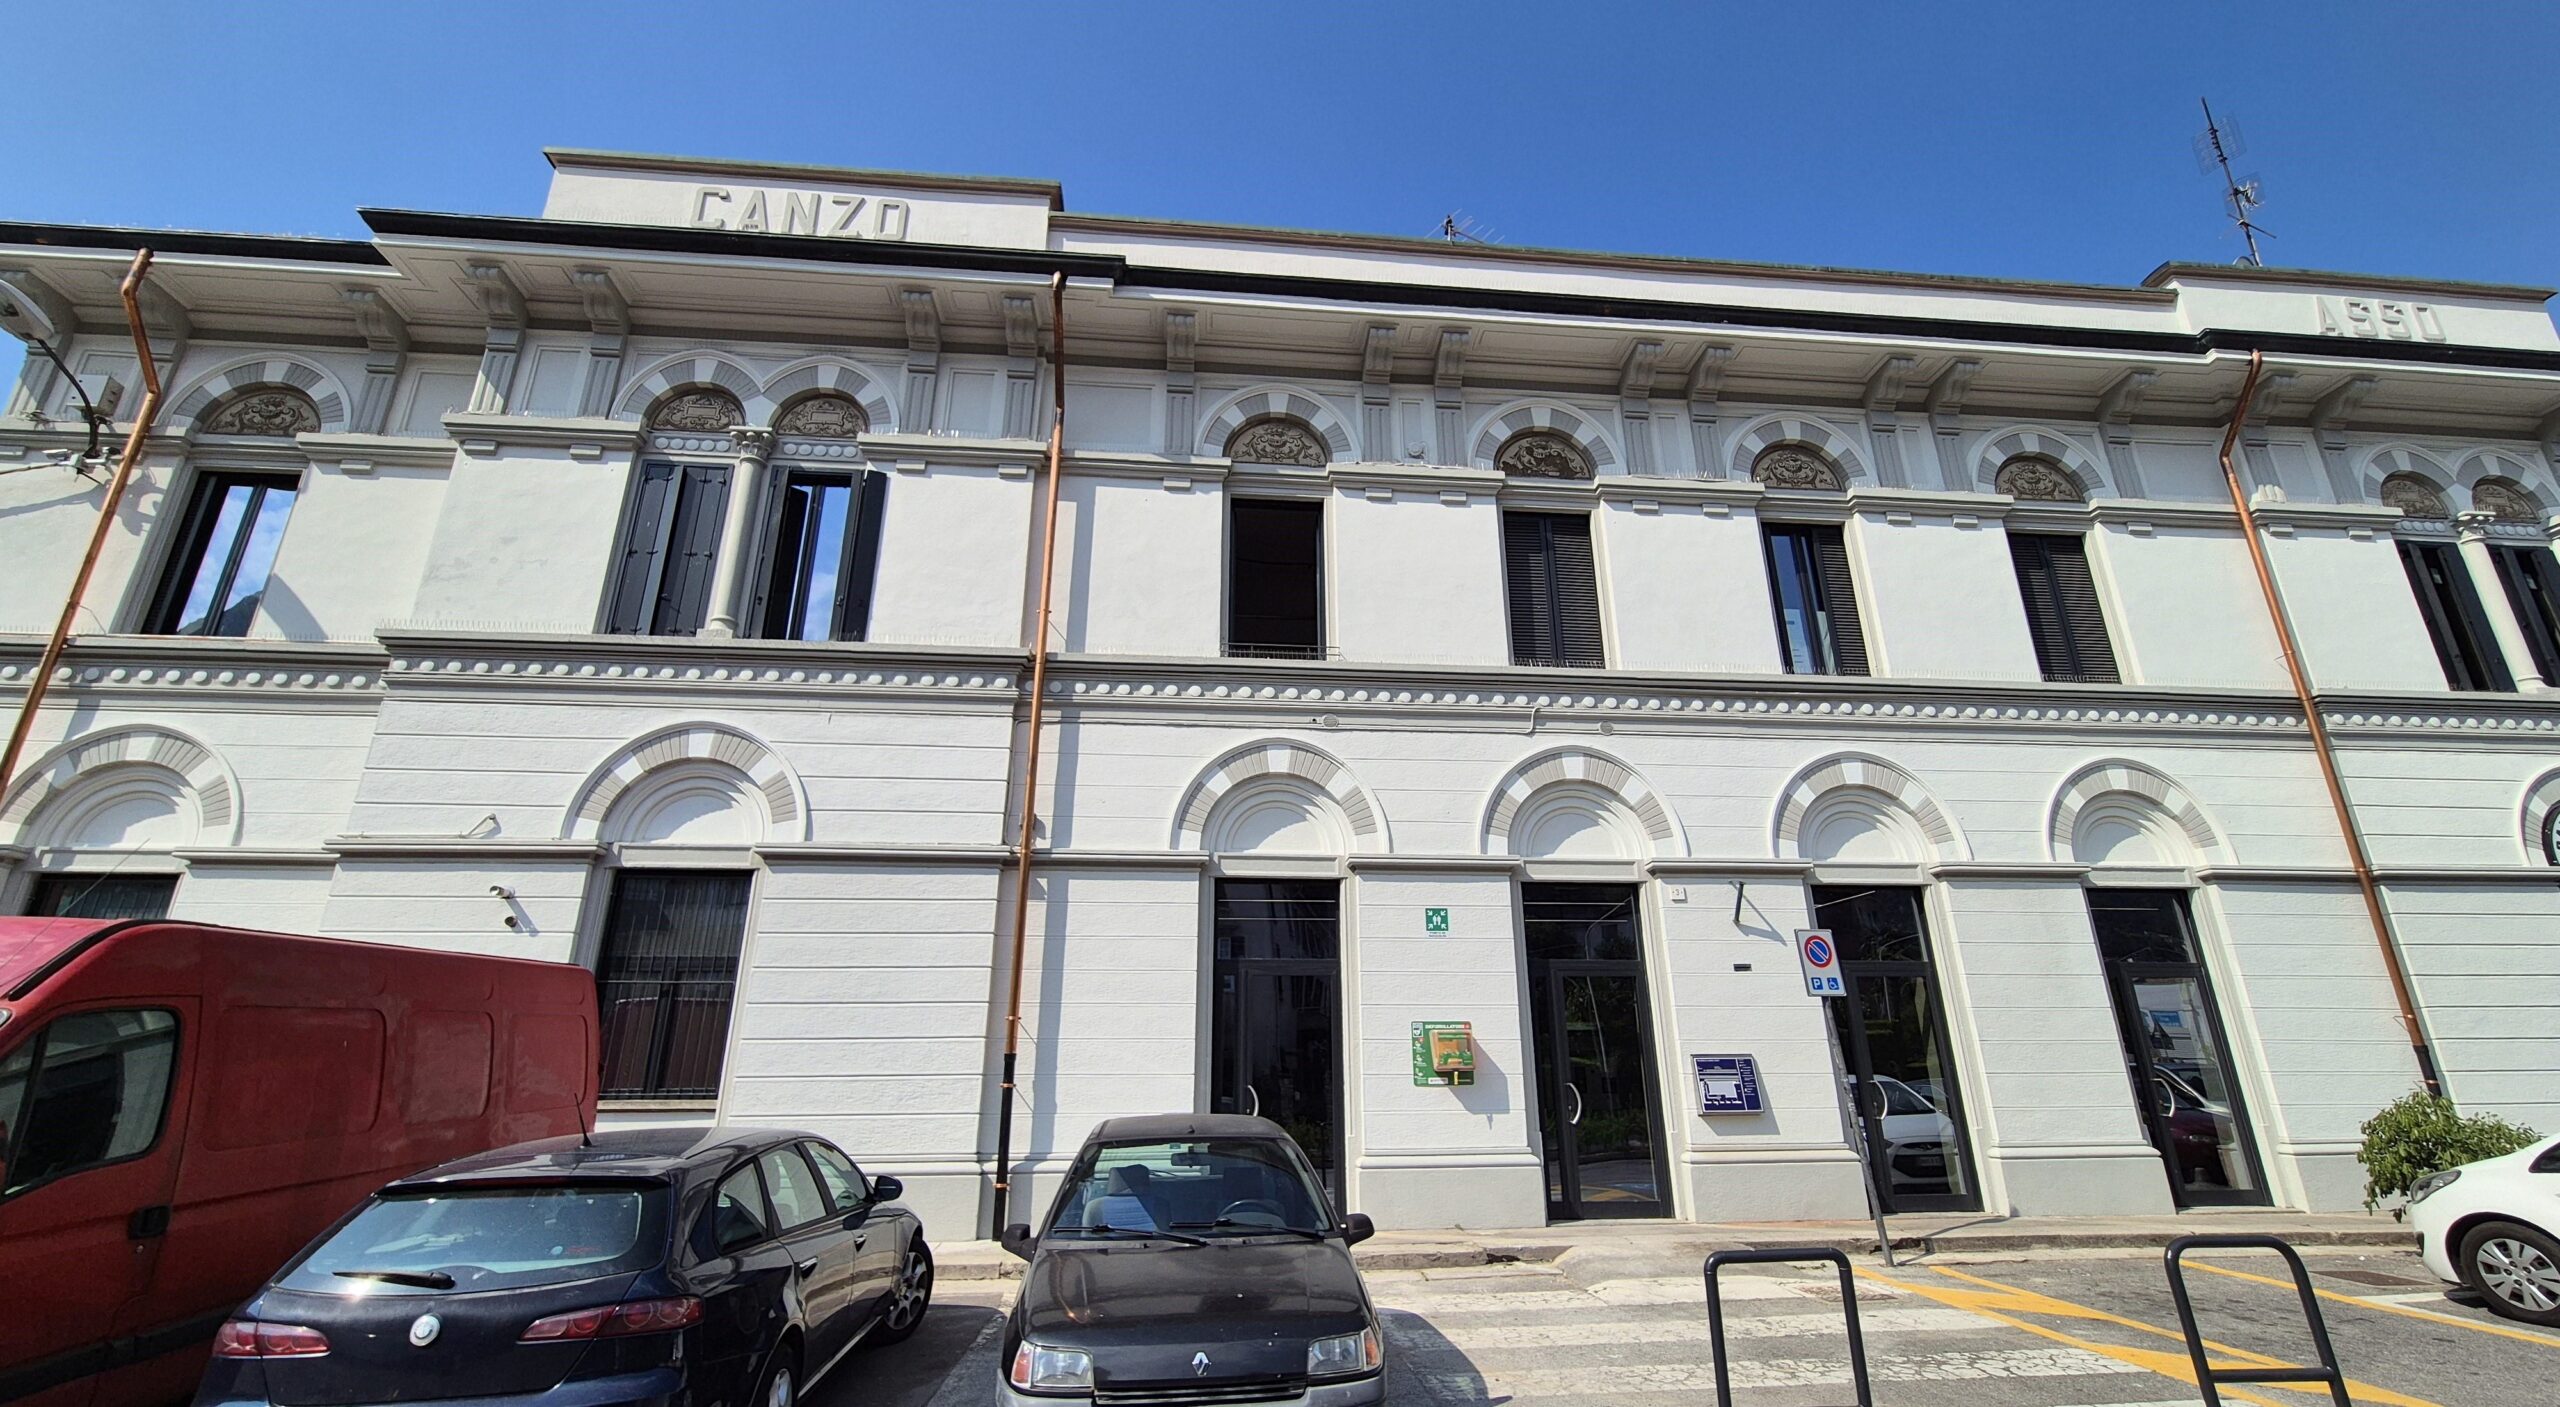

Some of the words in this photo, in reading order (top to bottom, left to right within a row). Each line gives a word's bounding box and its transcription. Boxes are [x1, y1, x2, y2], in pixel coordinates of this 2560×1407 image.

[690, 186, 909, 242] CANZO
[2316, 296, 2447, 343] ASSO
[1813, 978, 1820, 989] P
